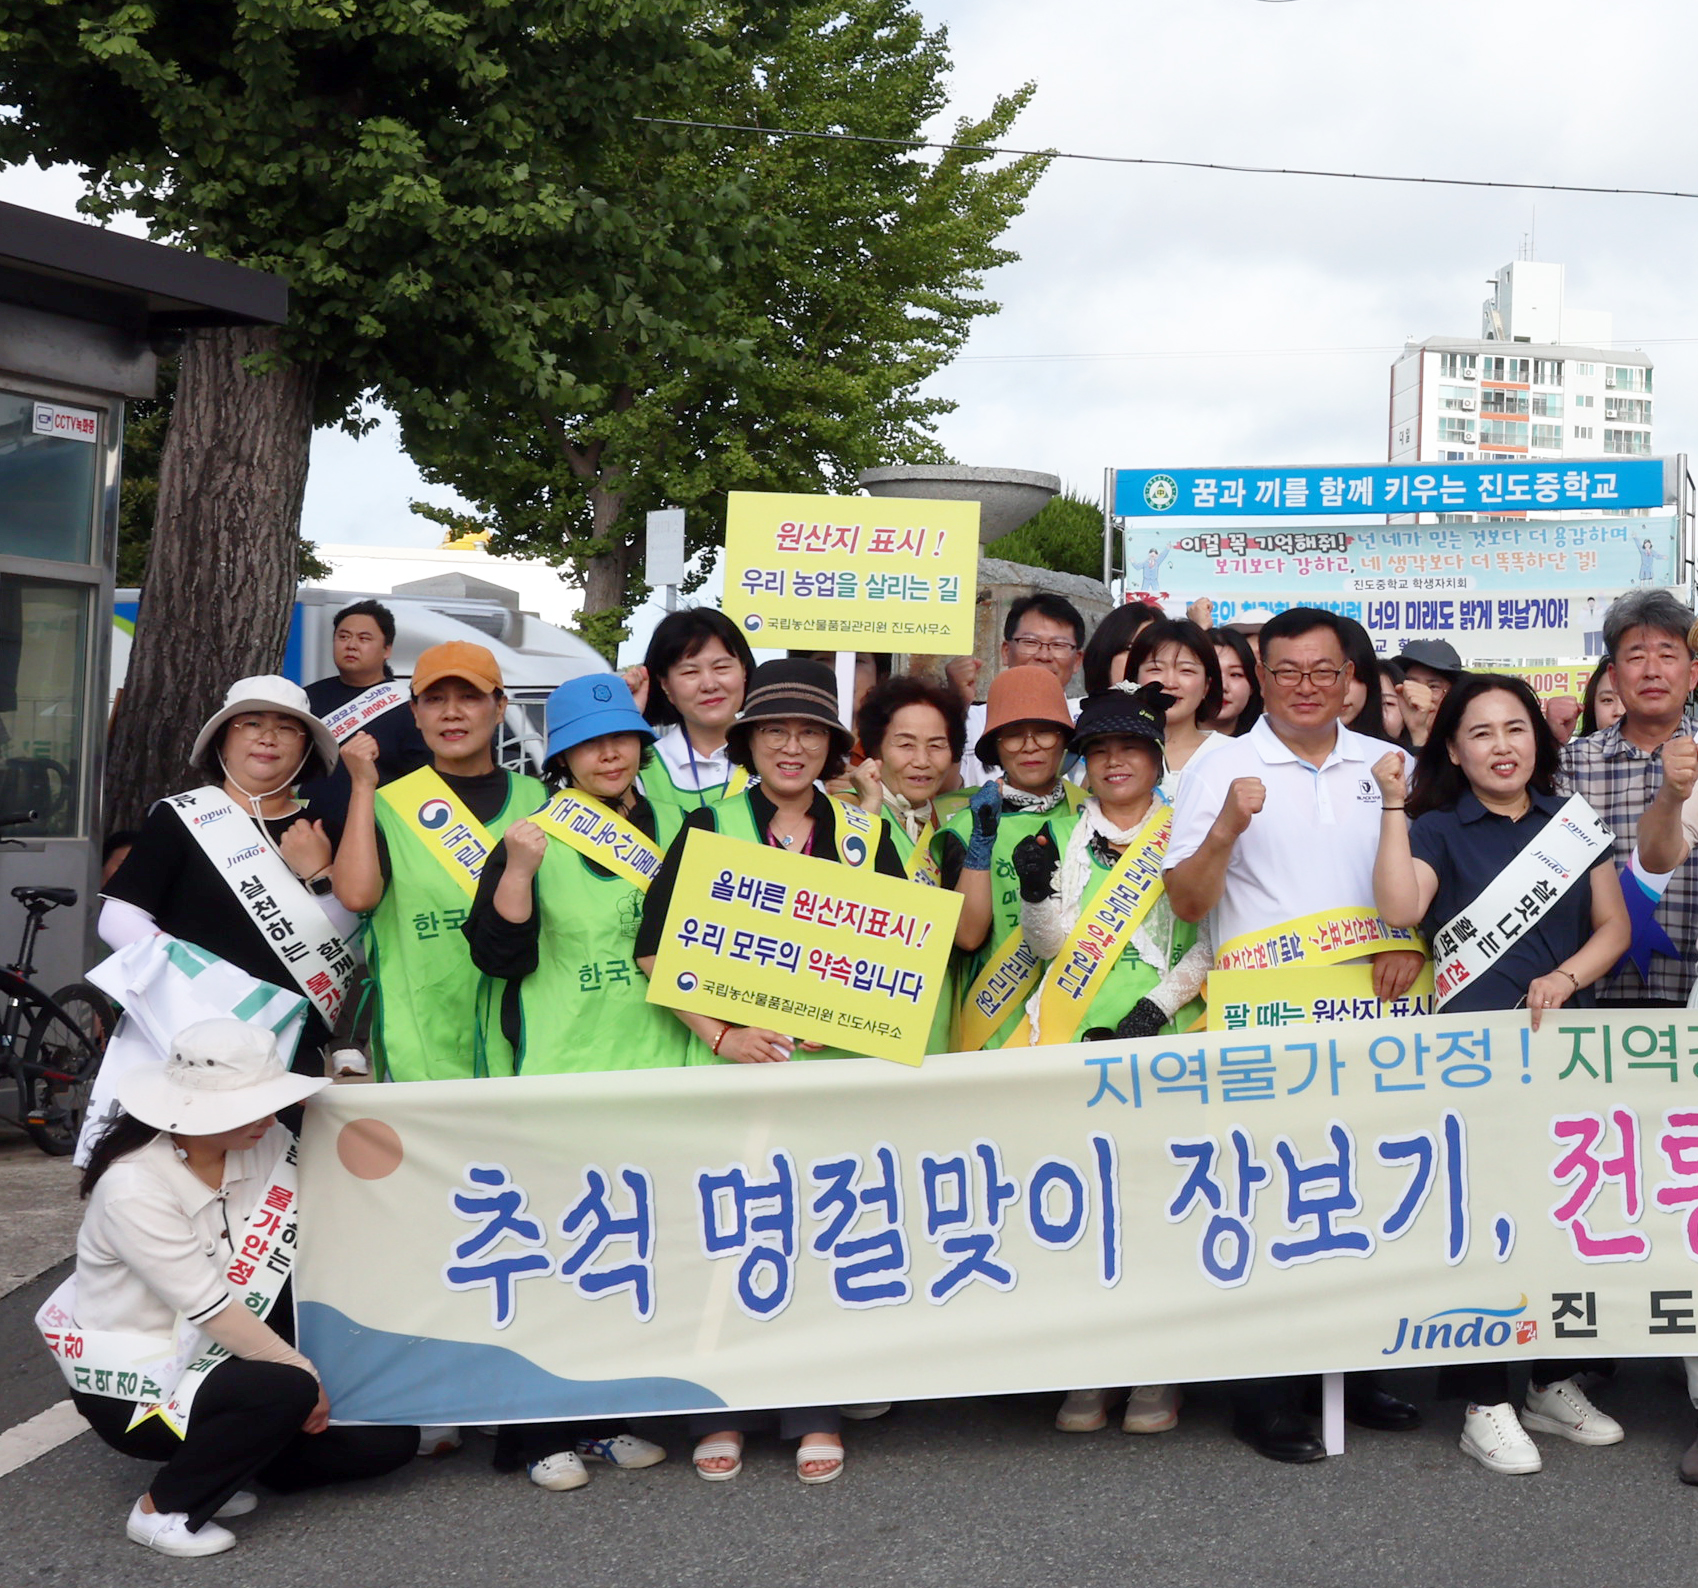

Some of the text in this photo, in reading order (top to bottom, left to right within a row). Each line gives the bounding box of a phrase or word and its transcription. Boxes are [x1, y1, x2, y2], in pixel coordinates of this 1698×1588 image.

[1191, 478, 1246, 508] 꿈과
[1254, 477, 1309, 508] 끼를
[1319, 476, 1373, 507] 함께
[1384, 474, 1467, 505] 키우는
[1477, 470, 1619, 503] 진도중학교
[775, 521, 861, 555] 원산지
[867, 527, 925, 557] 표시
[1180, 526, 1628, 557] 이걸 꼭 기억해줘! 넌 네가 믿는 것보다 더 용감하며
[741, 568, 959, 603] 우리 농업을 살리는 길
[1214, 550, 1597, 576] 보기보다 강하고, 네 생각보다 더 똑똑하단 걸!
[1353, 577, 1467, 591] 진도중학교 학생자치회
[767, 617, 951, 636] 국립농산물품질관리원 진도사무소
[1367, 600, 1399, 631] 너의
[1405, 600, 1454, 630] 미래도
[1460, 599, 1493, 630] 밝게
[1497, 598, 1569, 630] 빛날거야!
[710, 868, 788, 914] 올바른
[239, 874, 310, 963] 실천하는
[1476, 878, 1558, 959] 살맛나는
[677, 918, 924, 1004] 우리 모두의 약속입니다
[1056, 922, 1116, 1000] 약속입니다
[702, 980, 903, 1040] 국립농산물품질관리원 진도사무소
[1223, 1003, 1250, 1030] 팔
[1083, 1041, 1346, 1109] 지역물가
[1372, 1028, 1494, 1092] 안정
[226, 1184, 295, 1287] 물가안정
[444, 1165, 656, 1325] 추석
[695, 1130, 1124, 1318] 명절맞이
[1163, 1110, 1514, 1284] 장보기,
[1381, 1308, 1512, 1355] Jindo
